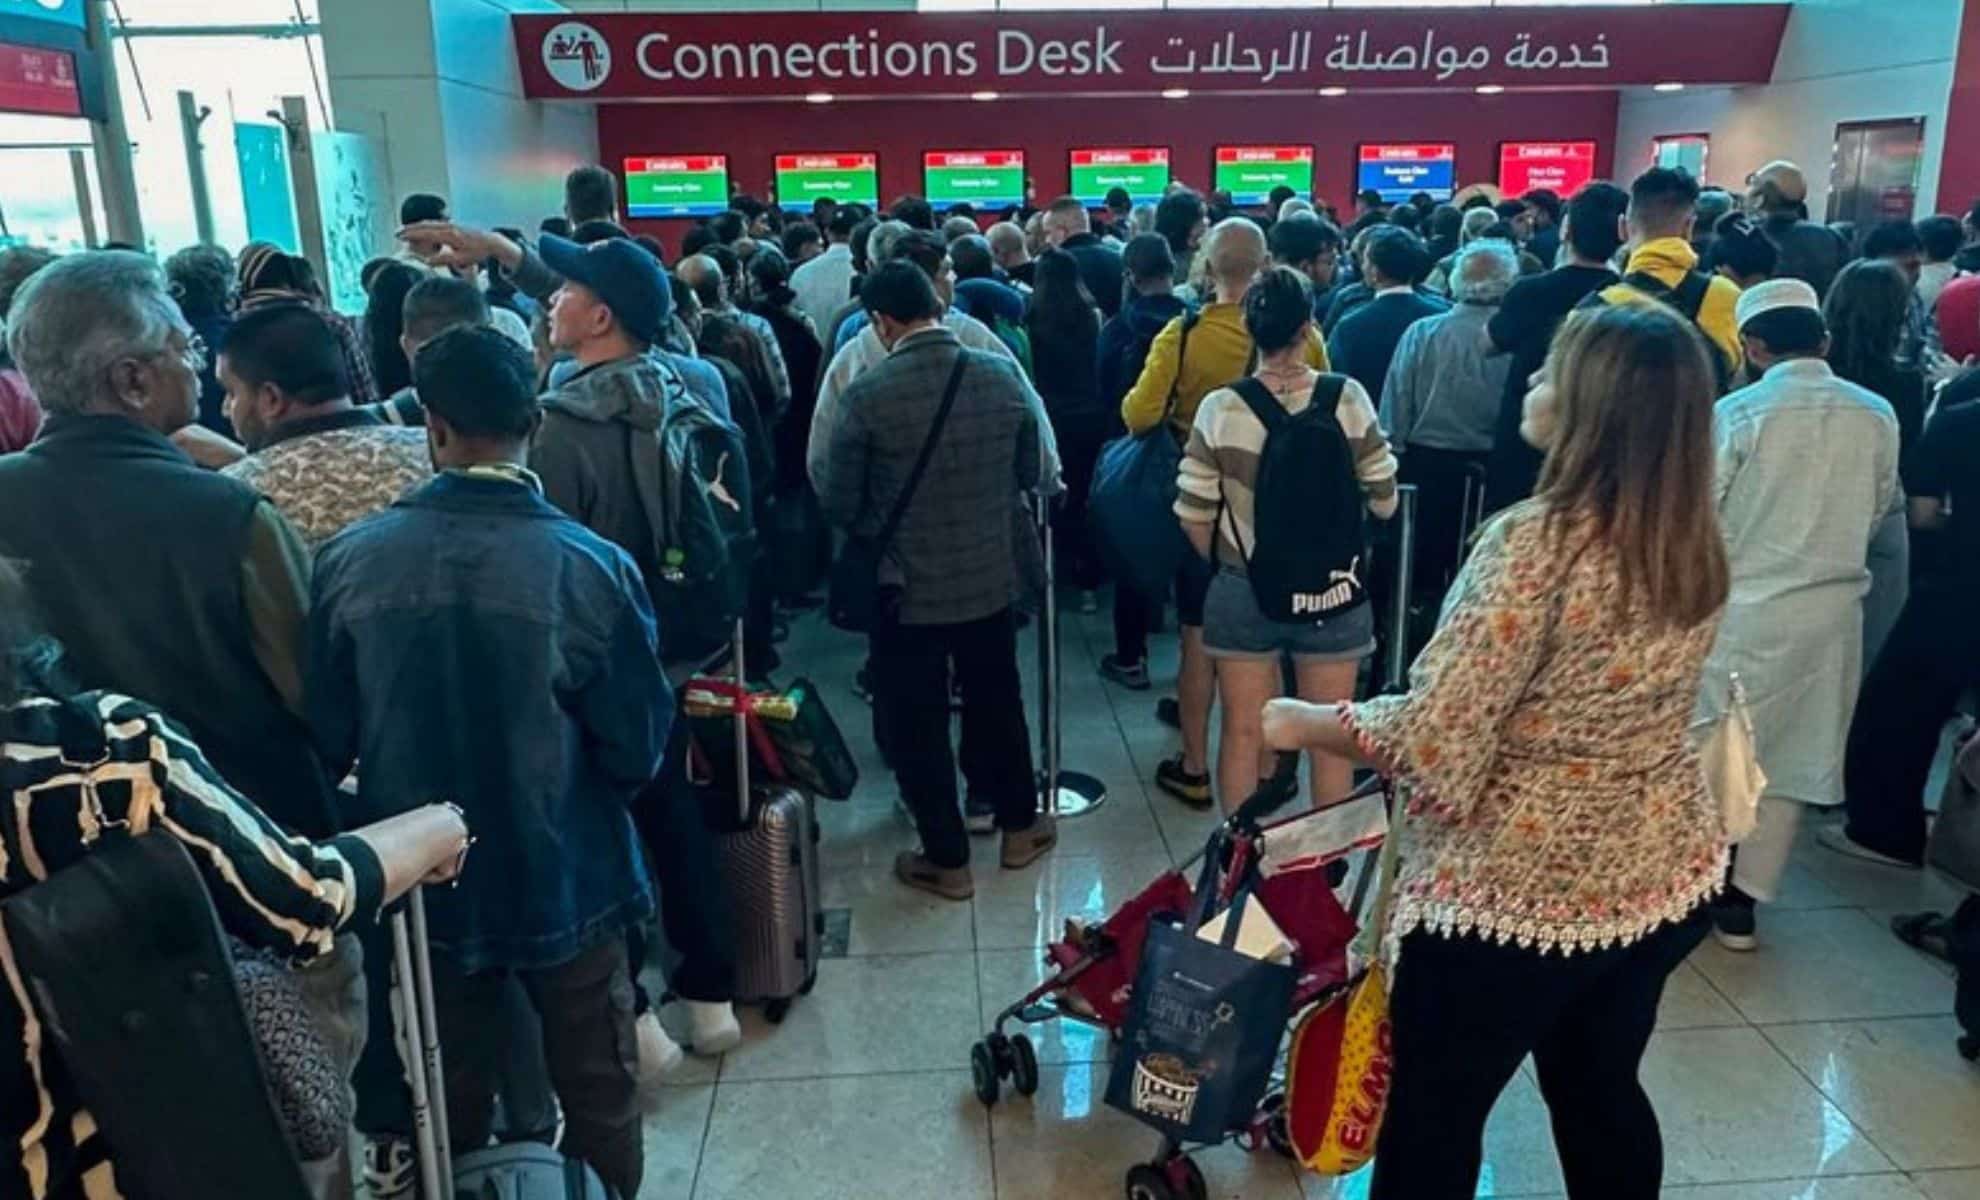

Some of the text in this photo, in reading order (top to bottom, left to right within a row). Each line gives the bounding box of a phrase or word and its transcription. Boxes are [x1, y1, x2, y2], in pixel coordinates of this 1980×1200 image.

[637, 25, 1123, 79] Connections Desk
[1150, 29, 1609, 83] خدمة مواصلة الرحلات
